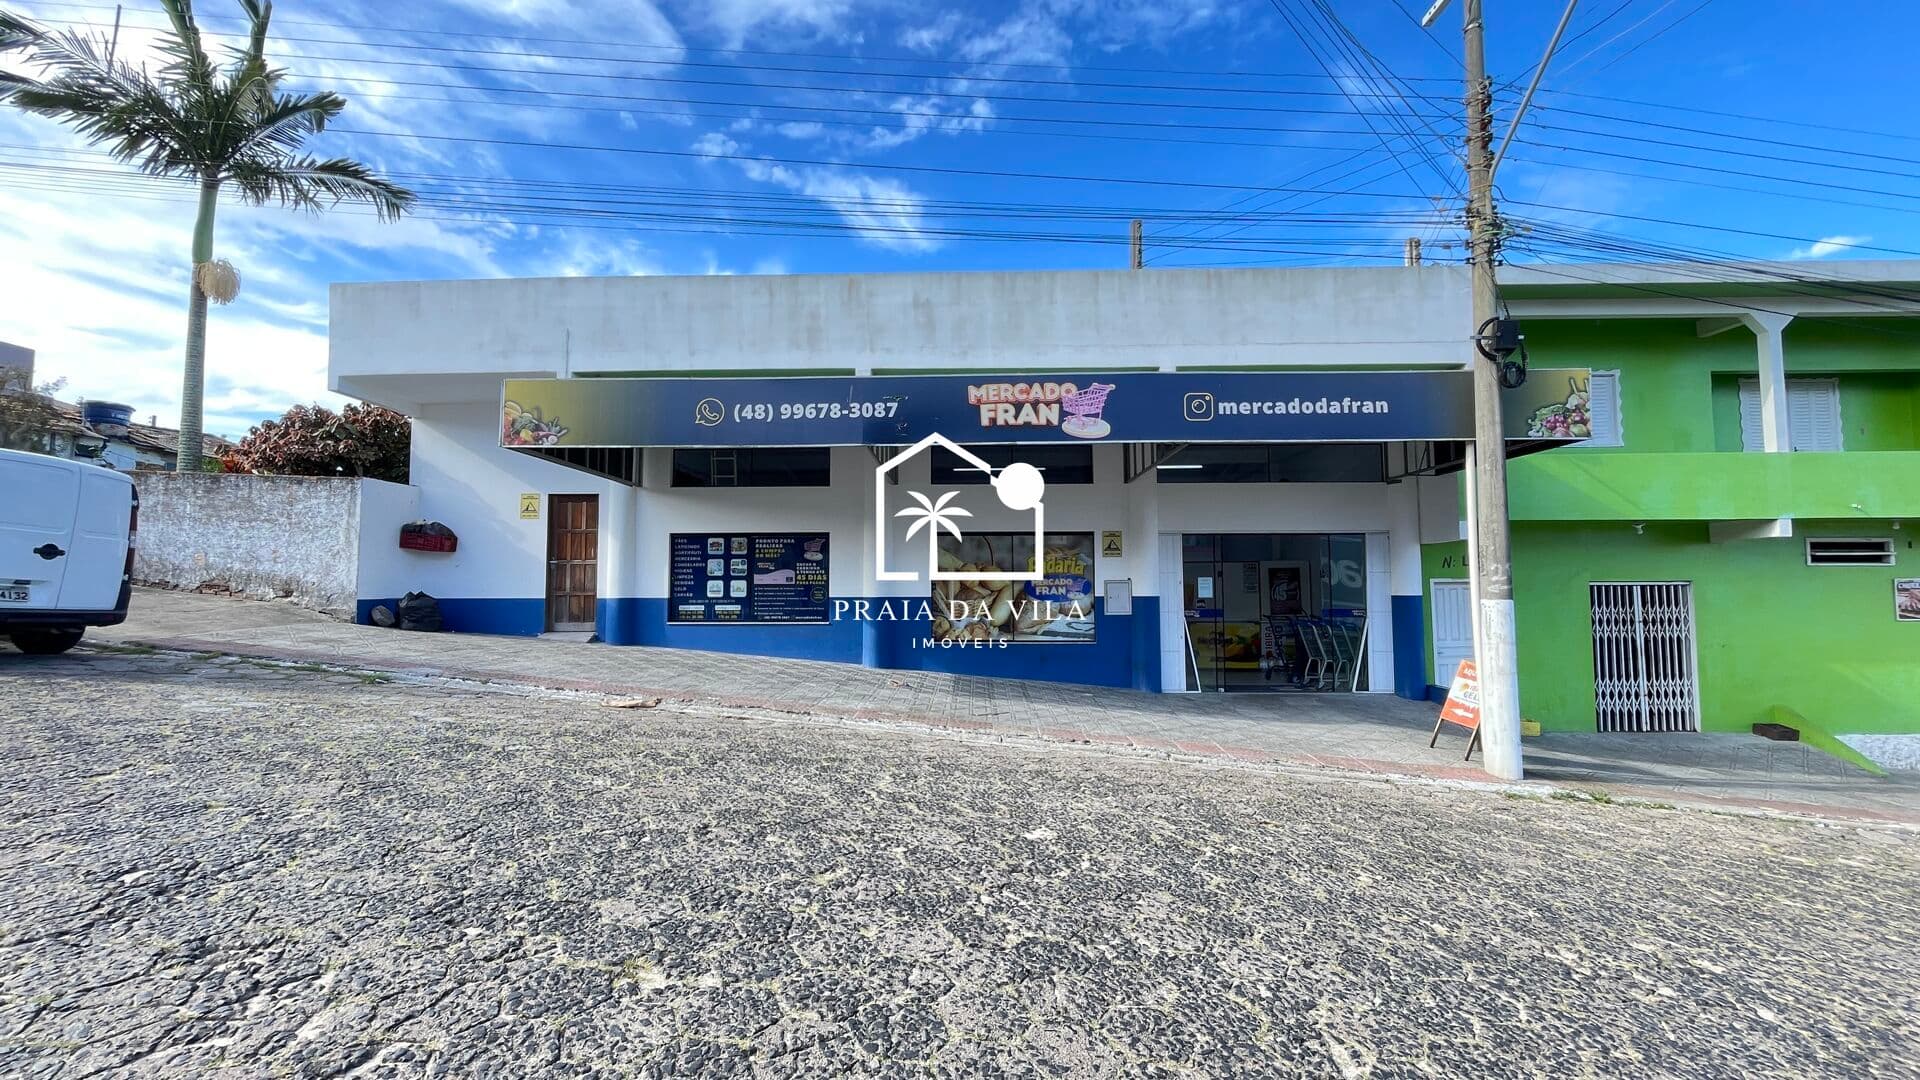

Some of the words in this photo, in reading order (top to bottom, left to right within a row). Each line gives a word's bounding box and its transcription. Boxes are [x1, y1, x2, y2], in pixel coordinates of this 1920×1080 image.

[967, 382, 1079, 405] MERCADO
[733, 404, 774, 423] (48)
[780, 402, 899, 420] 99678-3087
[979, 402, 1060, 428] FRAN
[1218, 397, 1389, 415] mercadodafran
[1035, 586, 1067, 596] FRAN
